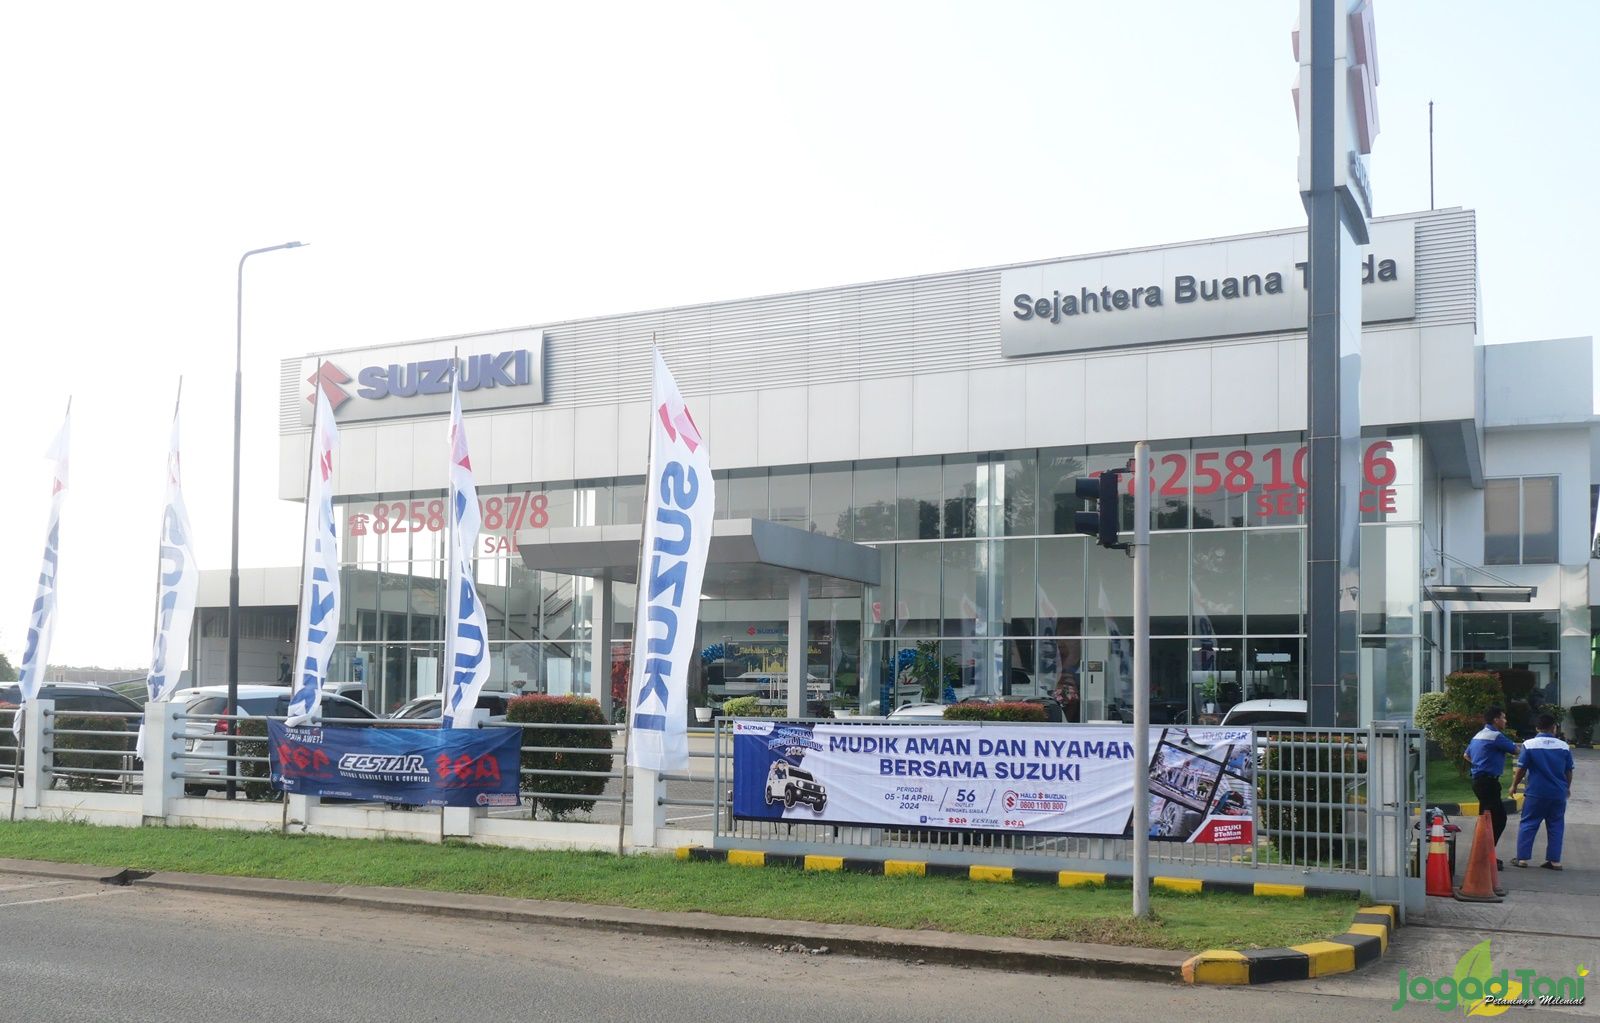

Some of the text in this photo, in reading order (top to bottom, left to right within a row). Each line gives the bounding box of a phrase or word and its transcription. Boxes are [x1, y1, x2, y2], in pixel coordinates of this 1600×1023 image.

[1013, 254, 1397, 324] Sejahtera Buana Tda
[357, 349, 530, 400] SUZUKI
[1127, 440, 1397, 496] 25816
[372, 490, 549, 535] 825887/8
[1255, 488, 1398, 518] SECE
[829, 736, 1135, 759] MUDIK AMAN DAN NYAMAN
[1224, 732, 1248, 740] GEAR
[338, 753, 429, 773] ECSTAR
[880, 758, 1080, 781] BERSAMA SUZUKI
[899, 802, 919, 810] 2024
[911, 794, 934, 802] APRIL
[956, 789, 976, 803] 56
